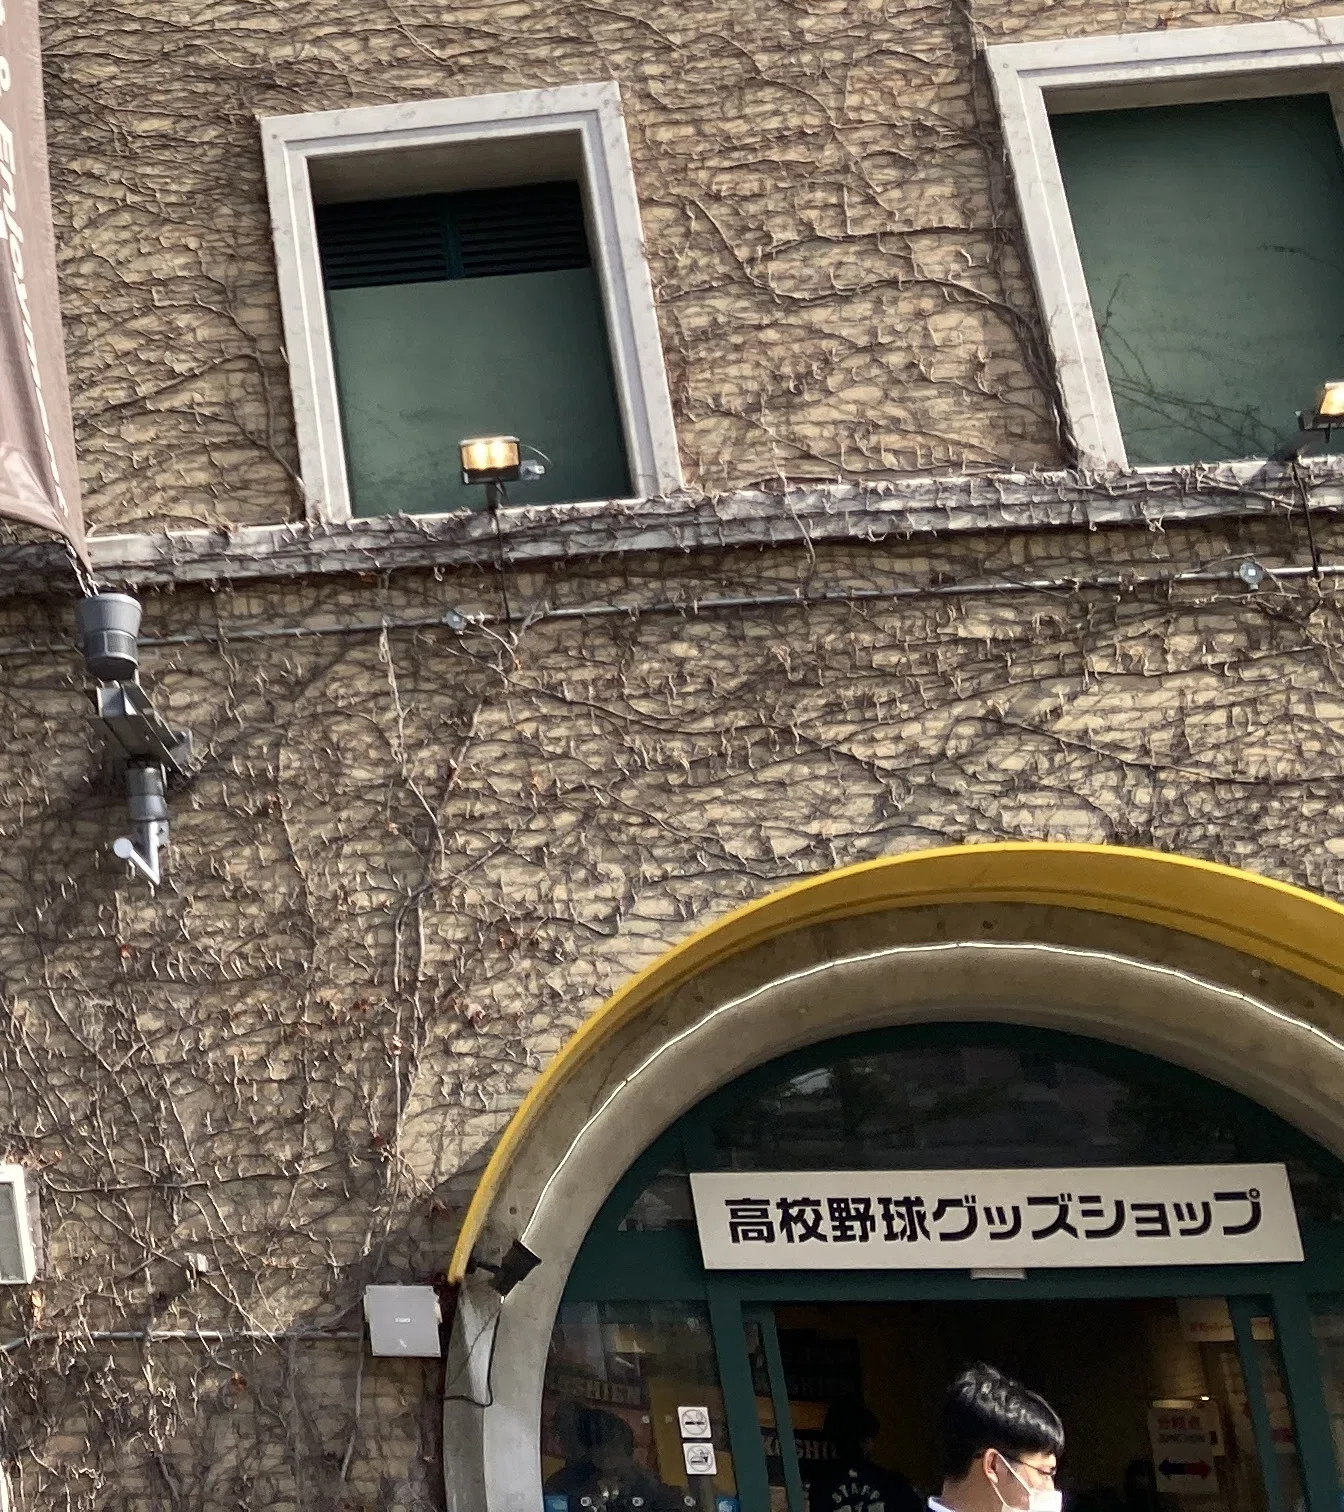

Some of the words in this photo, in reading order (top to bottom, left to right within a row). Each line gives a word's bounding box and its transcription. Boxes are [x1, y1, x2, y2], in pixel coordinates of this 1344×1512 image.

[724, 1187, 1263, 1245] 高校野球グッズショップ
